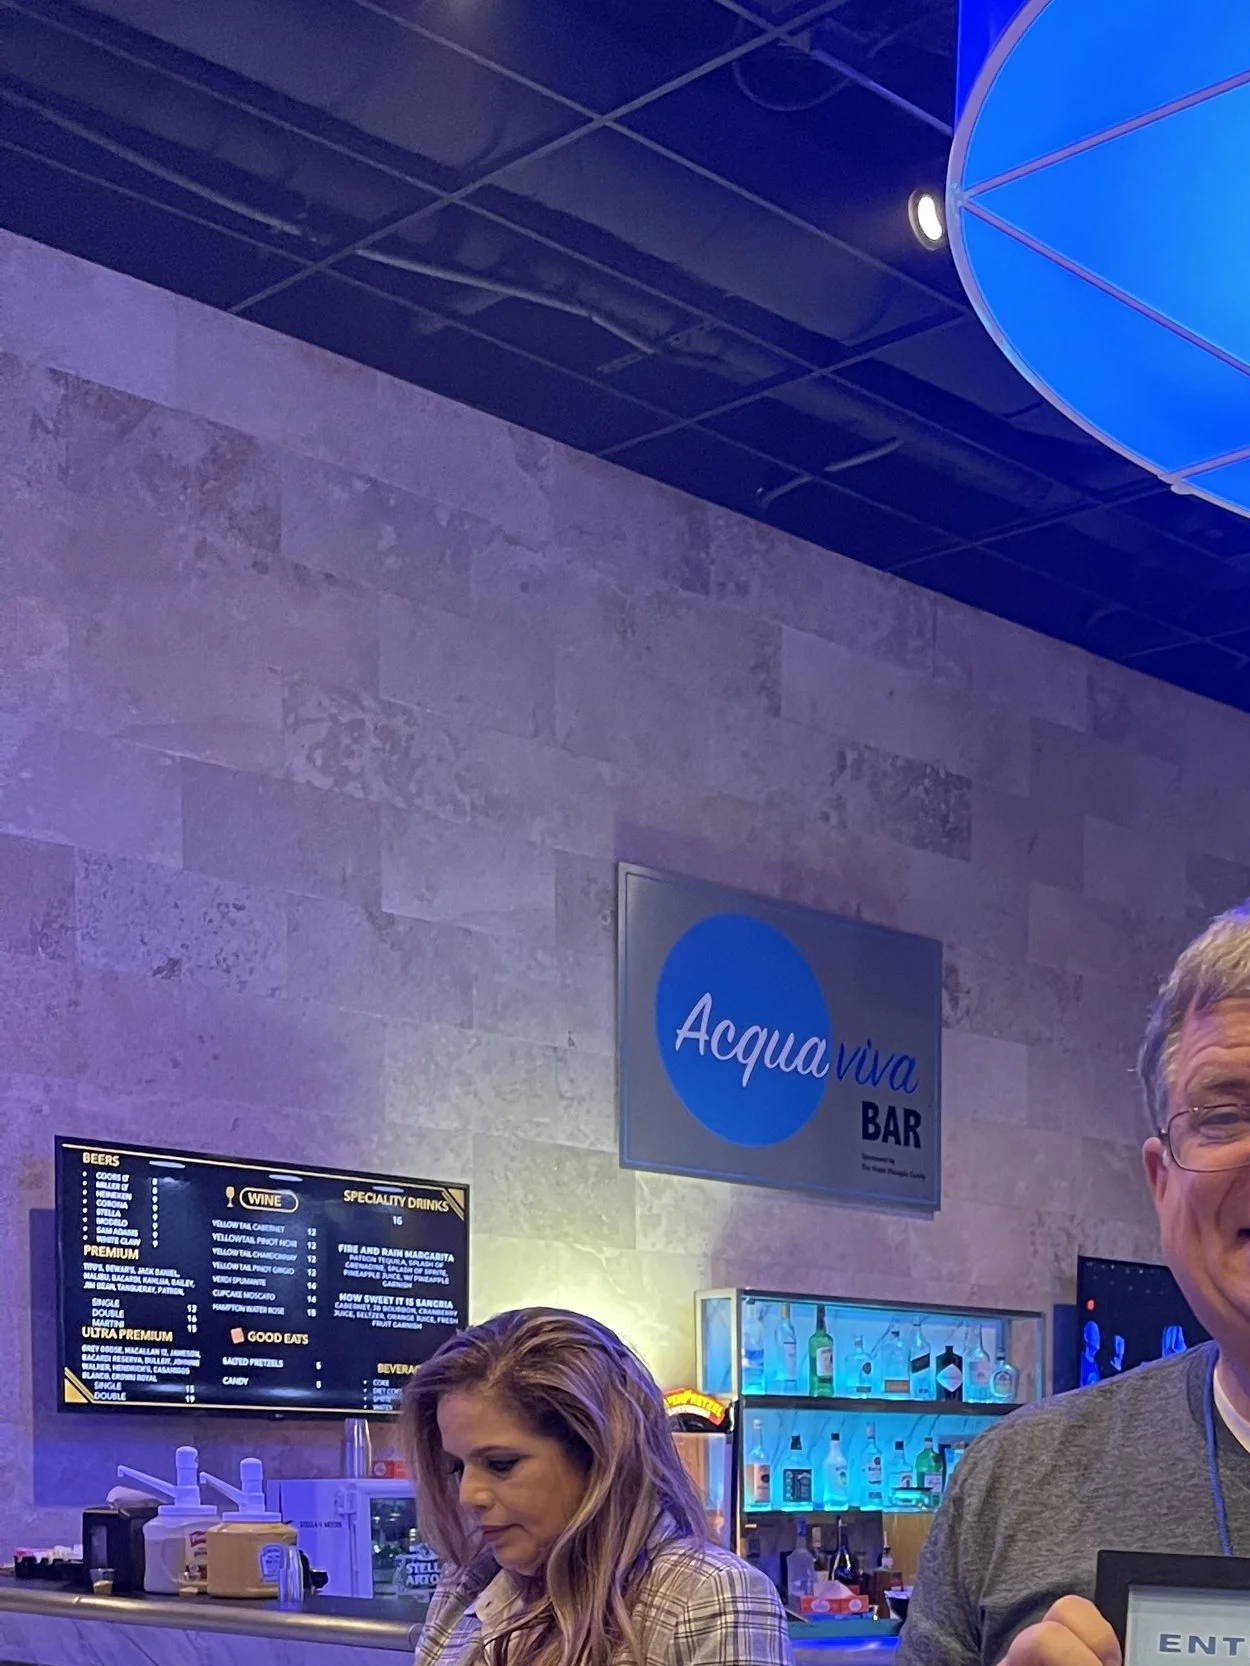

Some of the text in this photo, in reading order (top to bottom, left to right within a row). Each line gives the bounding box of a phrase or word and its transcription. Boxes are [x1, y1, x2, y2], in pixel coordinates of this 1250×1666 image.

[675, 992, 920, 1094] Acqua viva
[861, 1100, 922, 1149] BAR
[83, 1152, 120, 1167] BEERS
[96, 1172, 121, 1181] COORS
[96, 1181, 120, 1191] MILLER
[96, 1190, 132, 1200] HEINEKEN
[247, 1192, 282, 1207] WINE
[96, 1199, 128, 1209] CORONA
[343, 1189, 449, 1212] SPECIALITY DRINKS
[96, 1208, 121, 1217] STELLA
[96, 1217, 128, 1227] MODELO
[392, 1216, 403, 1225] 16
[96, 1226, 112, 1235] SAM
[113, 1228, 138, 1237] ADAMS
[307, 1228, 317, 1237] 12
[96, 1235, 119, 1245] WHITE
[120, 1237, 141, 1247] CLAW
[307, 1242, 317, 1250] 12
[84, 1245, 139, 1259] PREMIUM
[338, 1243, 455, 1263] FIRE AND RAIN MARGARITA
[307, 1255, 317, 1263] 12
[408, 1259, 434, 1268] SPLASH
[434, 1261, 445, 1269] OF
[307, 1269, 317, 1277] 12
[387, 1265, 413, 1274] SPLASH
[413, 1267, 423, 1275] OF
[343, 1269, 381, 1280] PINEAPPLE
[413, 1275, 450, 1285] PINEAPPLE
[382, 1280, 413, 1289] GARNISH
[243, 1291, 276, 1301] MOSCATO
[339, 1292, 453, 1310] HOW SWEET IT IS SANGRIA
[92, 1298, 197, 1313] SINGLE 13
[246, 1305, 267, 1314] WATER
[92, 1309, 197, 1323] DOUBLE 16
[92, 1319, 125, 1328] MARTINI
[372, 1320, 422, 1330] FRUIT GARNISH
[82, 1326, 173, 1341] ULTRA PREMIUM
[247, 1331, 309, 1345] GOOD EATS
[222, 1356, 284, 1368] SALTED PRETZELS
[94, 1381, 122, 1390] SINGLE
[222, 1376, 249, 1386] CANDY
[373, 1379, 390, 1387] COKE
[94, 1392, 126, 1401] DOUBLE
[406, 1574, 440, 1586] ARTO
